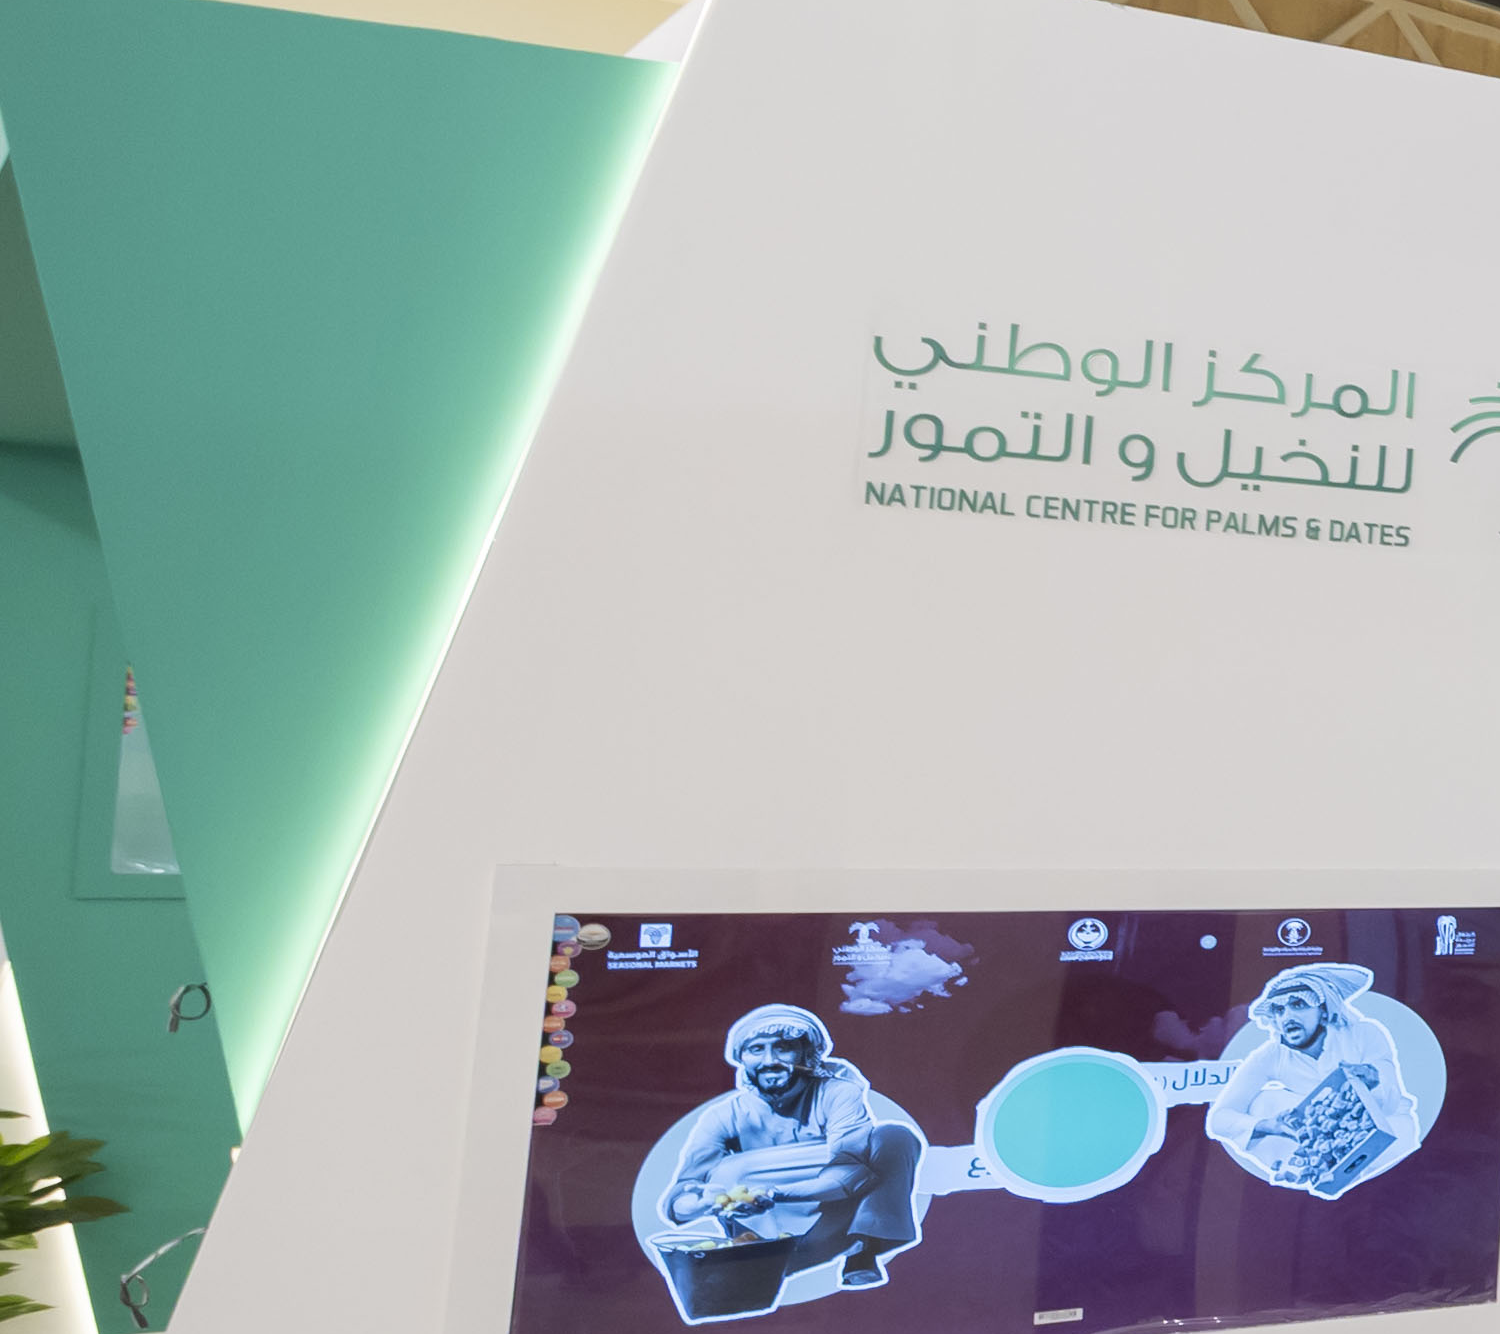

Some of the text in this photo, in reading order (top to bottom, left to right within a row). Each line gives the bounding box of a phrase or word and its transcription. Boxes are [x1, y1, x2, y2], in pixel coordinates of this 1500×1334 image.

[873, 321, 1416, 419] المركز الوطني
[868, 410, 1415, 494] للنخيل و التمور
[864, 481, 1410, 547] NATIONAL CENTRE FOR PALMS & DATES
[607, 960, 697, 970] SEASONAL MARKETS
